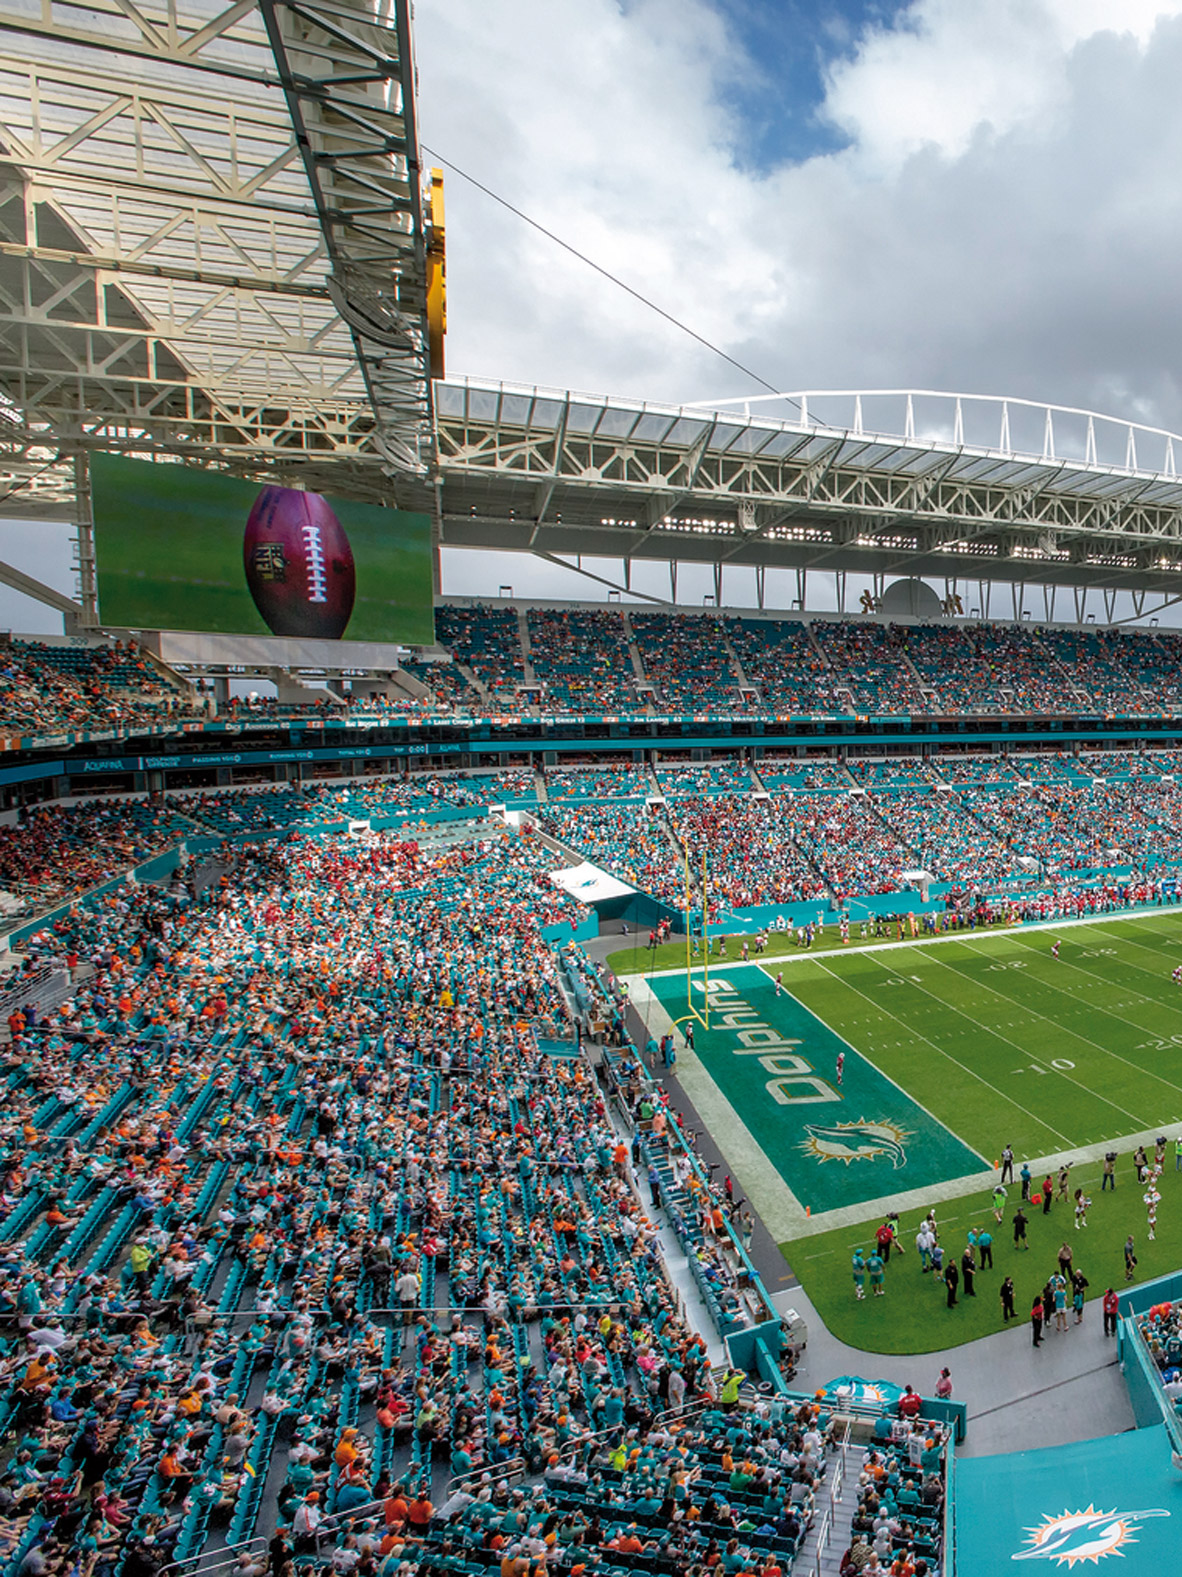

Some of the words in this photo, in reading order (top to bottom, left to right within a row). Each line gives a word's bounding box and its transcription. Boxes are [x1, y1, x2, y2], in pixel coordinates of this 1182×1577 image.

[69, 637, 89, 646] 309
[83, 760, 124, 772] AQUAFINA
[691, 978, 845, 1105] Dolphins
[1027, 1058, 1076, 1076] 10
